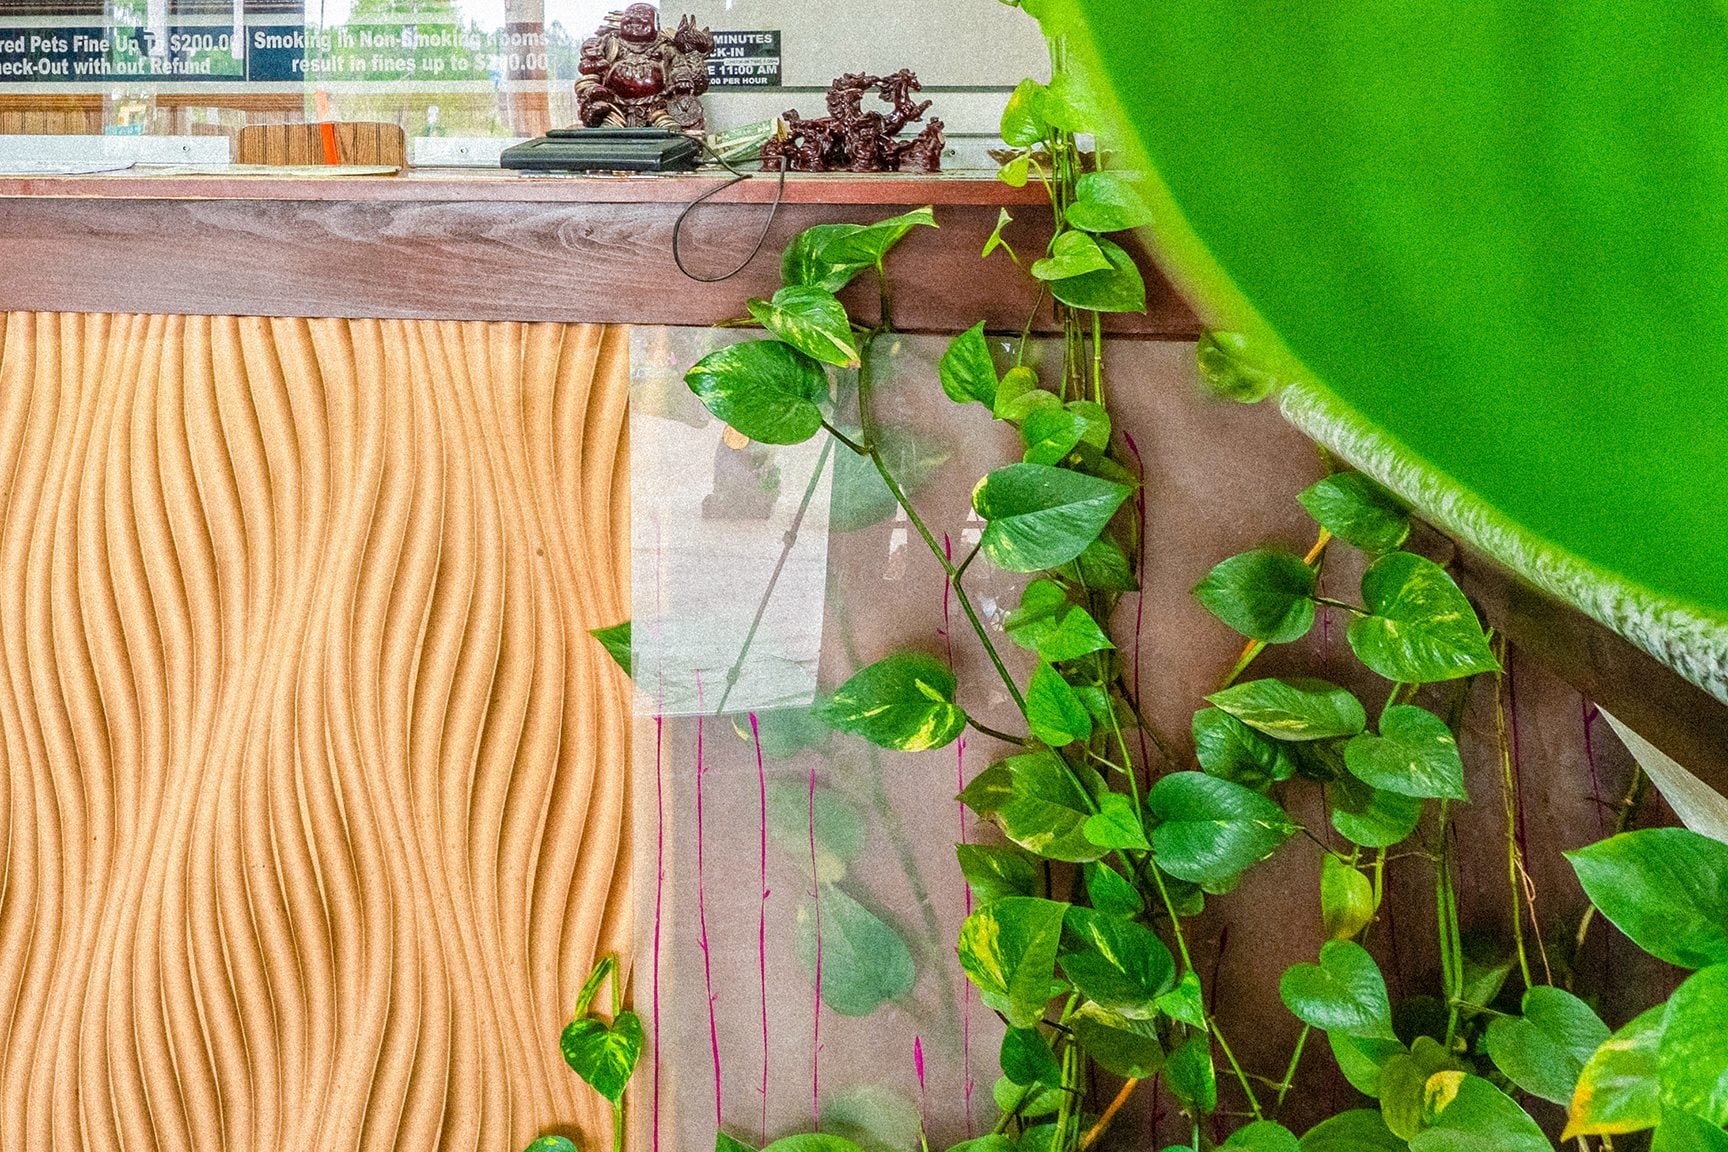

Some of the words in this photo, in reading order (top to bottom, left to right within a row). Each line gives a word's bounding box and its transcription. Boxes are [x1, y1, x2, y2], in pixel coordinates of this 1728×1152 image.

[31, 36, 68, 53] Pets
[74, 35, 109, 53] Fine
[116, 35, 138, 55] Up
[170, 33, 236, 54] $200.0
[254, 31, 331, 52] Smoking
[337, 31, 354, 48] in
[359, 30, 481, 51] Non-Smoking
[713, 34, 773, 44] MINUTES
[74, 58, 111, 75] with
[117, 58, 145, 75] out
[150, 57, 211, 75] Refund
[292, 55, 344, 72] result
[349, 55, 366, 72] in
[372, 55, 416, 72] fines
[422, 57, 445, 75] up
[450, 56, 469, 71] to
[719, 65, 753, 75] 11:00
[757, 65, 778, 75] AM
[722, 77, 740, 85] PER
[742, 77, 768, 85] HOUR
